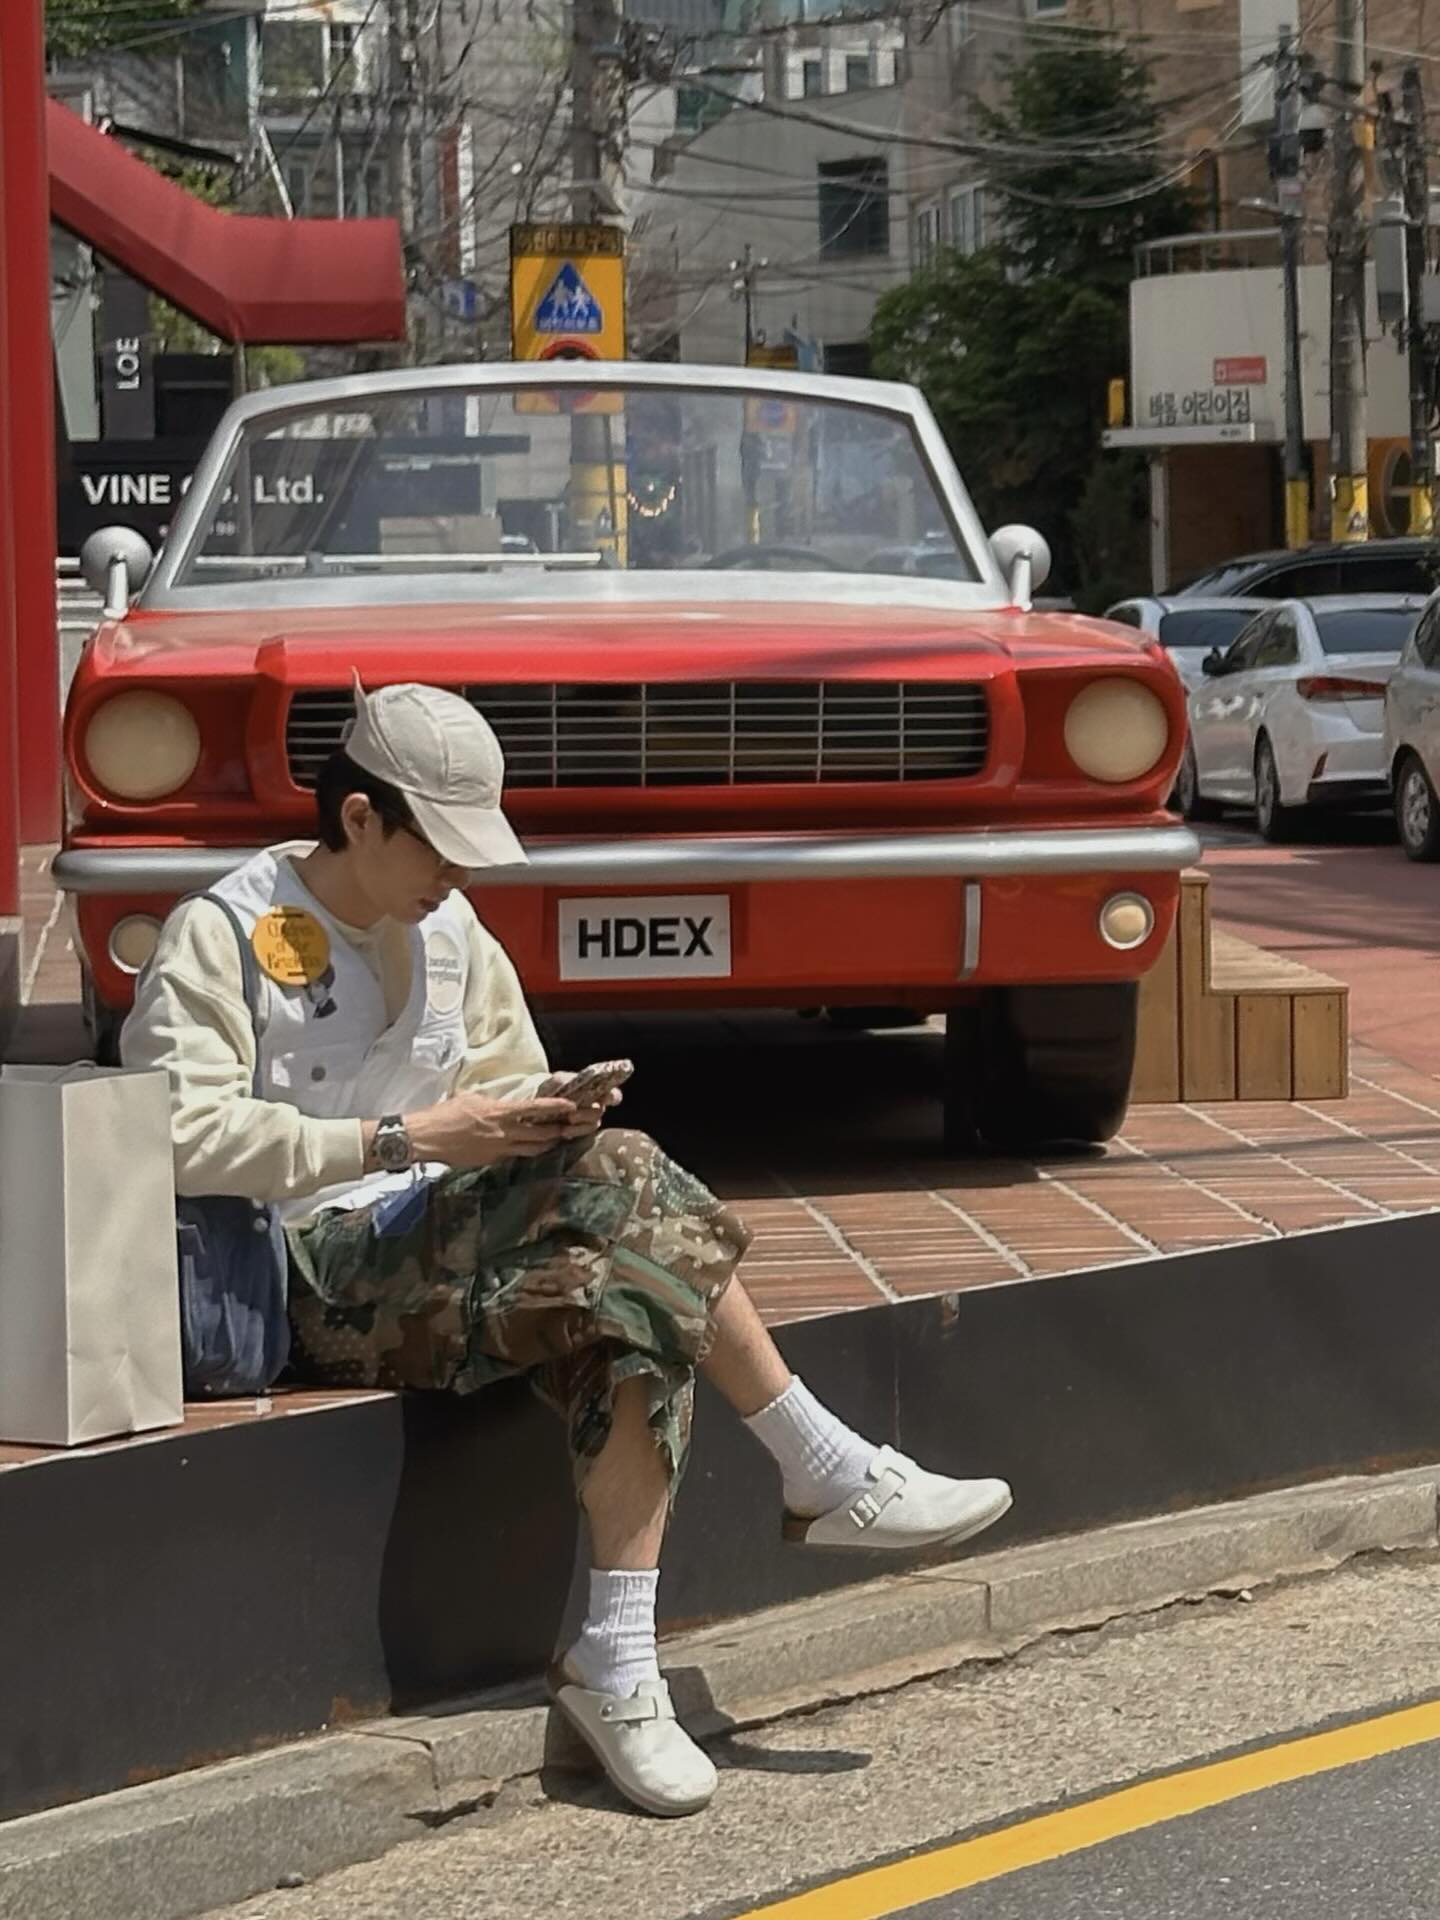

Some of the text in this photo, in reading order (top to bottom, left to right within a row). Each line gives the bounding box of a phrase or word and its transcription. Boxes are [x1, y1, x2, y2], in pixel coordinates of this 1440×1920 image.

[115, 337, 140, 390] LOE
[1182, 388, 1251, 425] 어린이집
[81, 473, 171, 504] VINE
[254, 474, 325, 504] Ltd.
[578, 916, 714, 958] HDEX
